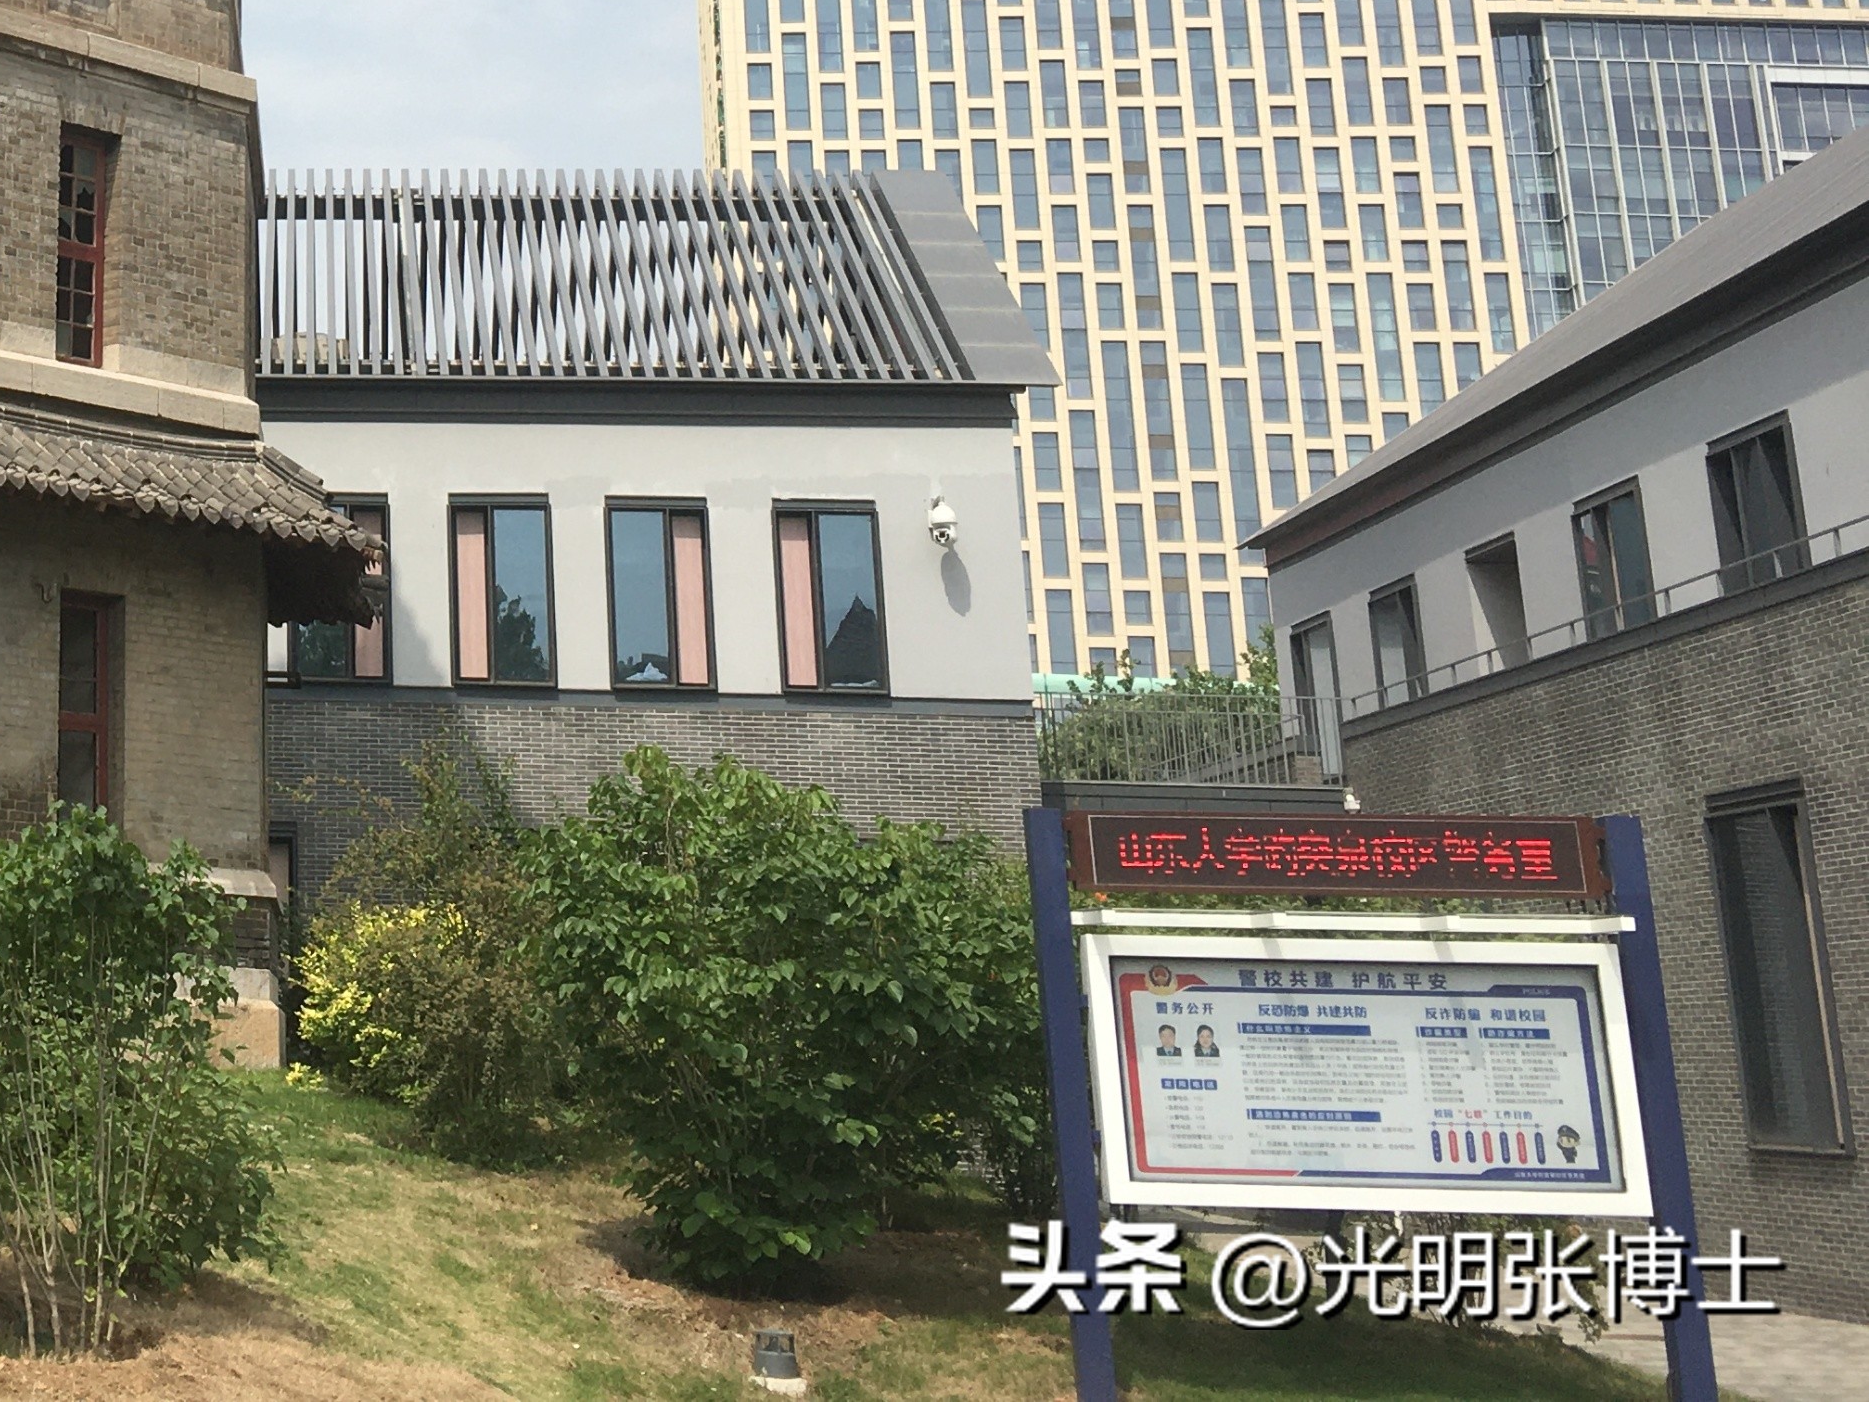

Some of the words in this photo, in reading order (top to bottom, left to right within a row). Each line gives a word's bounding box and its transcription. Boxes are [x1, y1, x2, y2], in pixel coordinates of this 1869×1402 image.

[1239, 969, 1334, 988] 警校共建
[1352, 972, 1447, 991] 护航平安
[1156, 1002, 1214, 1015] 警务公开
